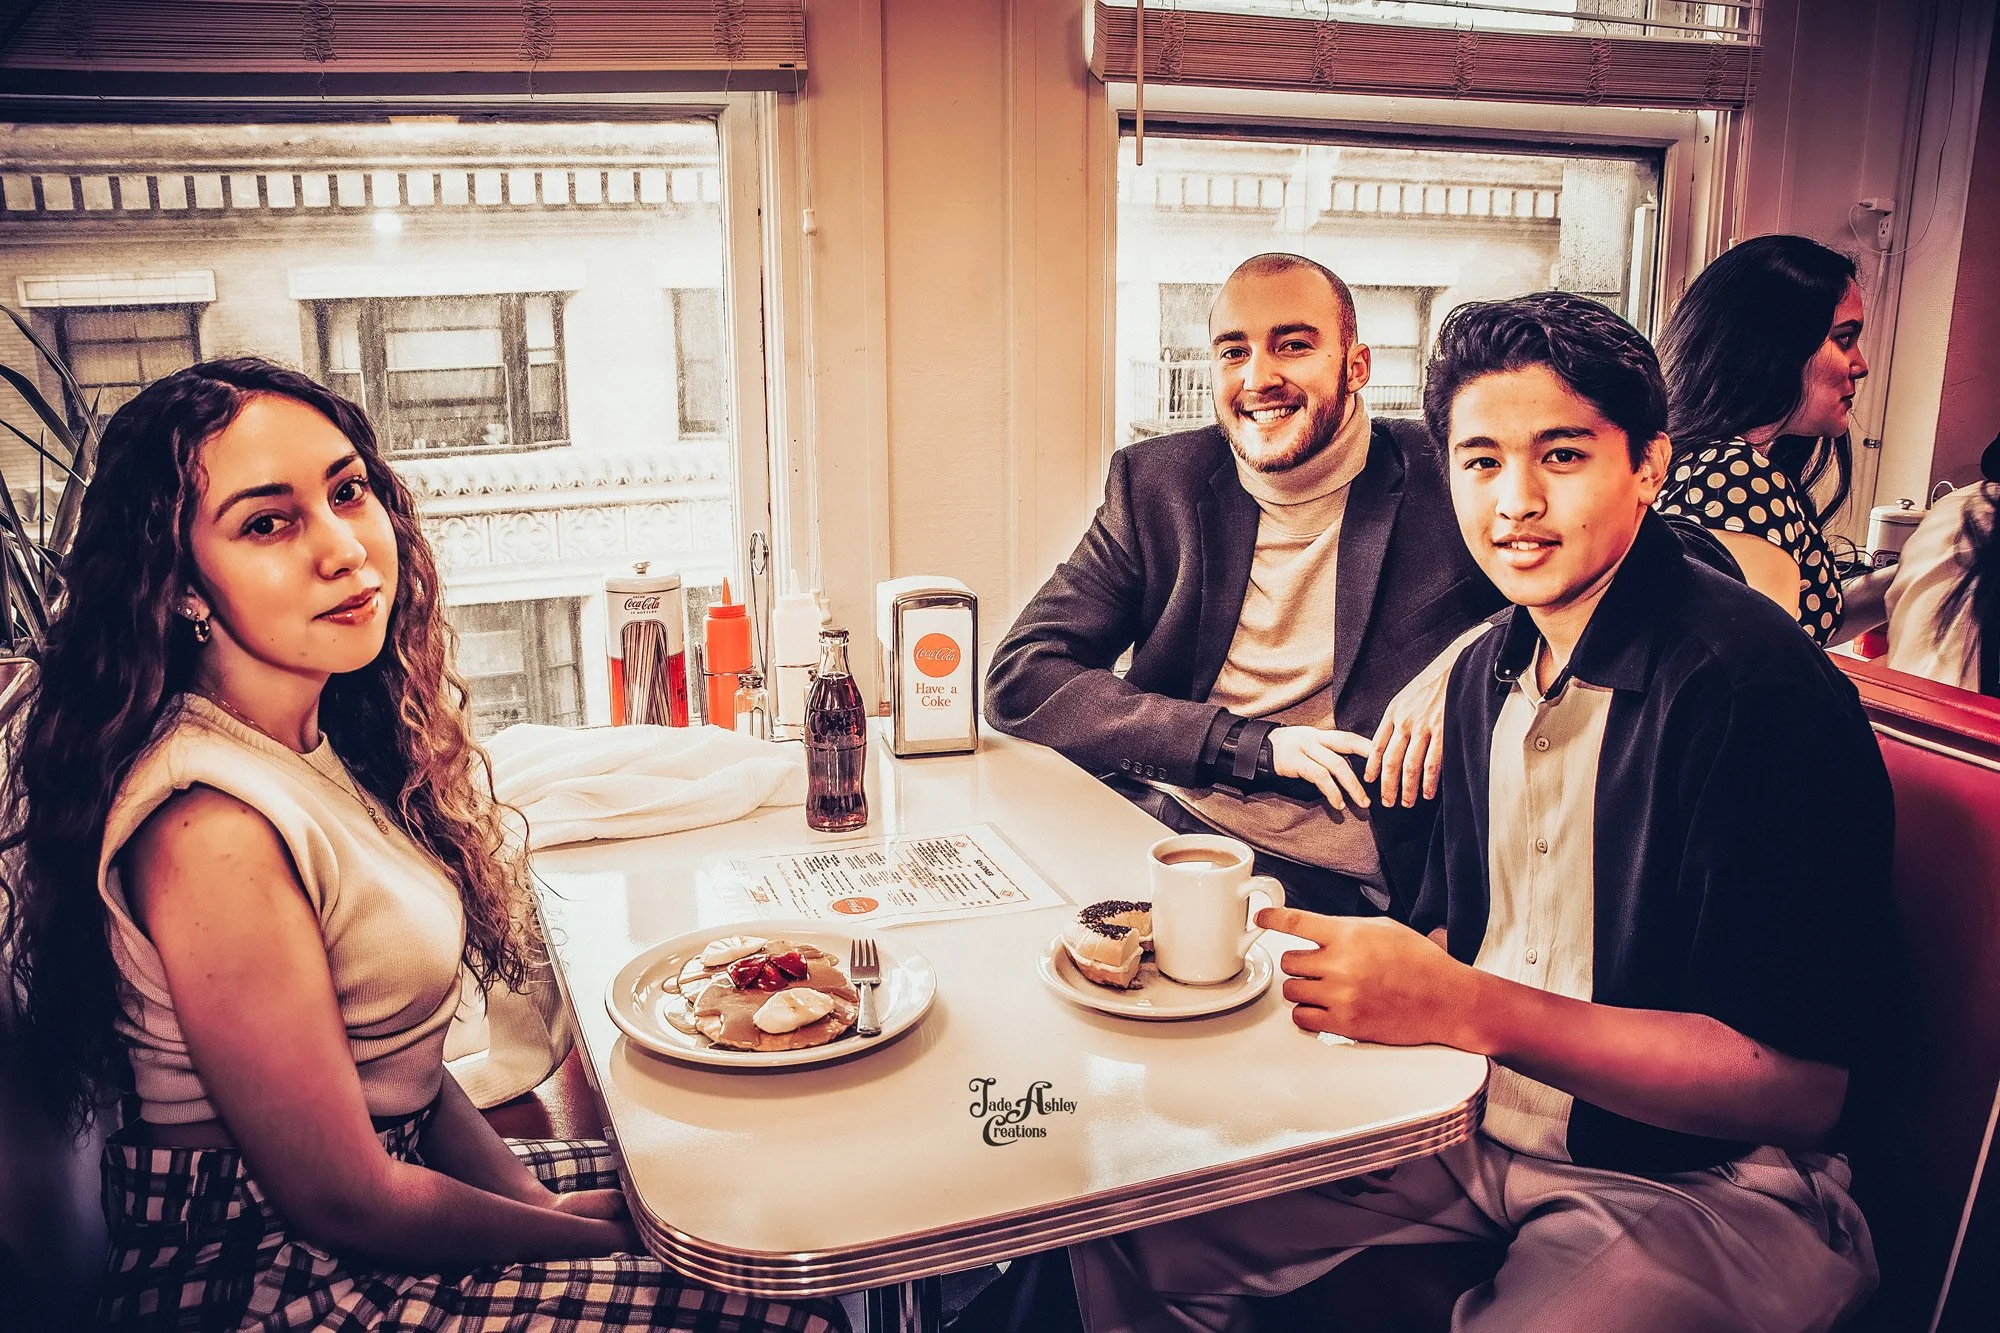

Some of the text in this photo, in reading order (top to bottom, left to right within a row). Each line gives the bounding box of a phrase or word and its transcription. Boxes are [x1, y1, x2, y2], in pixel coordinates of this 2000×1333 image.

[915, 683, 958, 694] Have a
[921, 696, 952, 707] Coke
